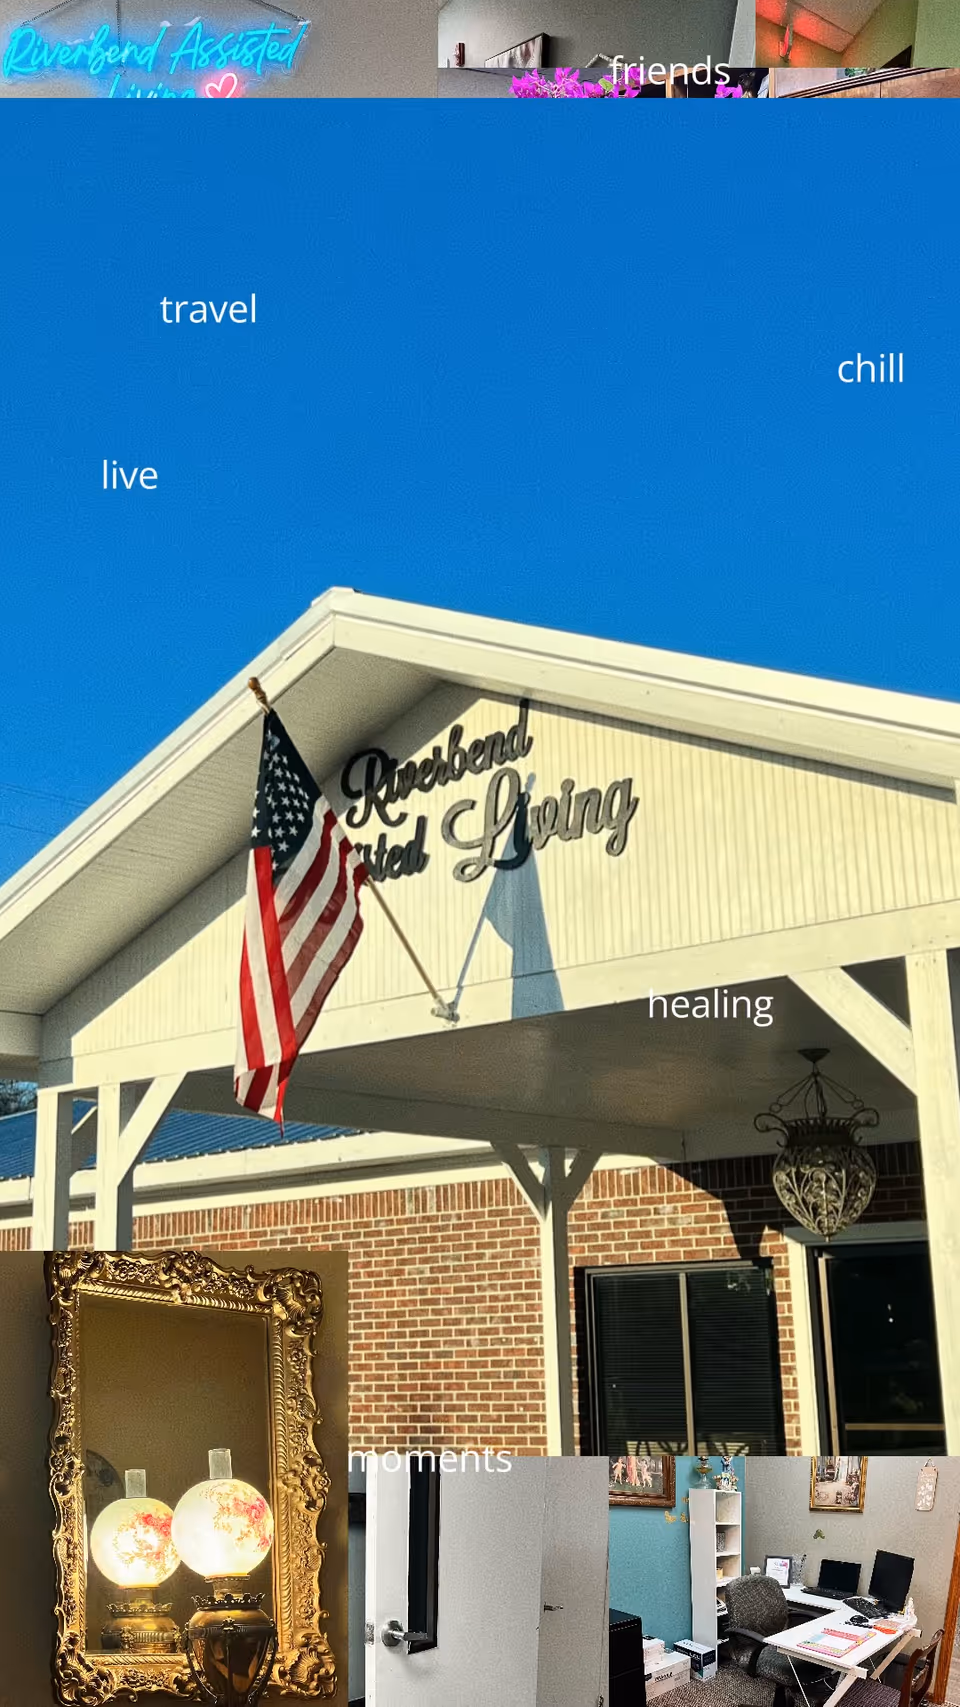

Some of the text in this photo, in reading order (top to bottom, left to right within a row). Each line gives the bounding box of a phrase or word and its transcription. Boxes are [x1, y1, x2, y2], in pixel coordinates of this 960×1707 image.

[169, 21, 309, 75] Assisted
[341, 699, 534, 828] Riverbend
[441, 767, 639, 882] Living
